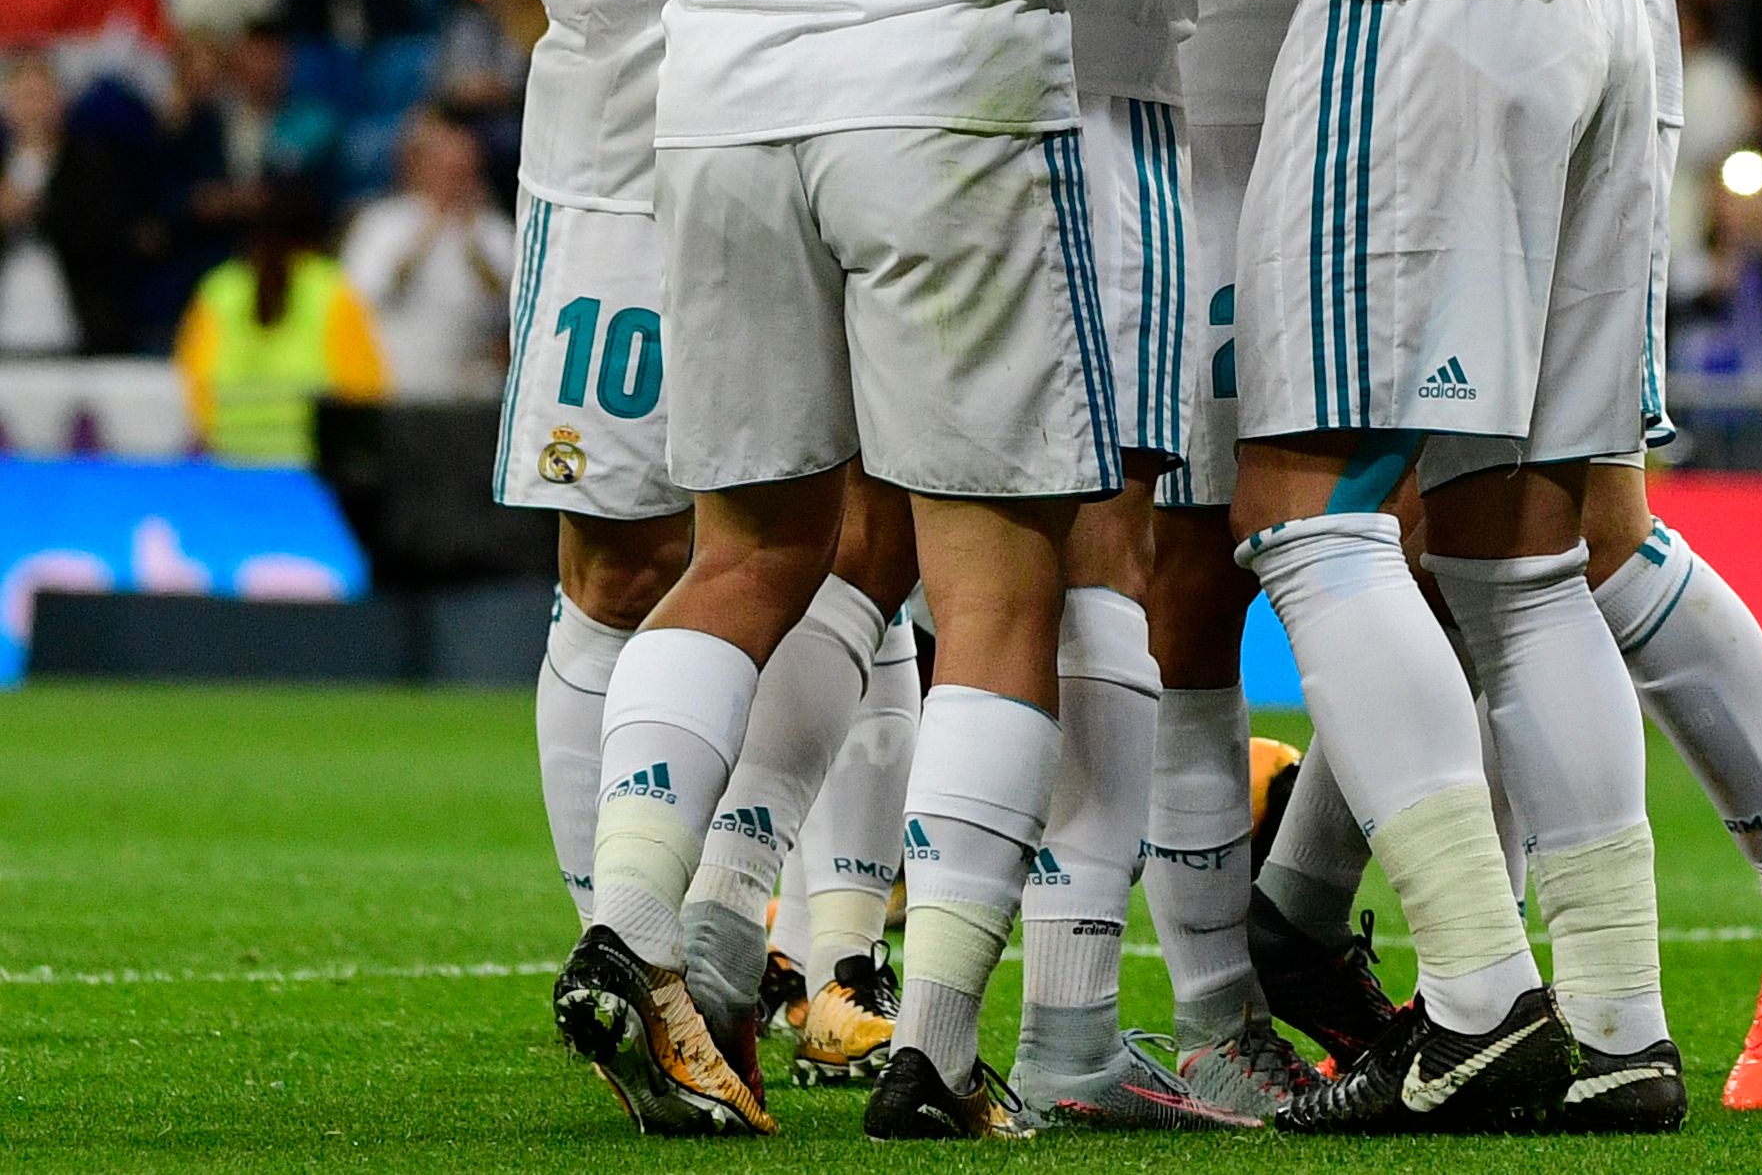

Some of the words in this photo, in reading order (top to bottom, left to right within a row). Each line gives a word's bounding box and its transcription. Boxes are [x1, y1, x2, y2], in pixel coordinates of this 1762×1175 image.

[554, 295, 664, 420] 10
[1417, 383, 1477, 401] adidas
[607, 784, 678, 806] adidas
[711, 818, 778, 851] adidas
[833, 856, 895, 884] RMC
